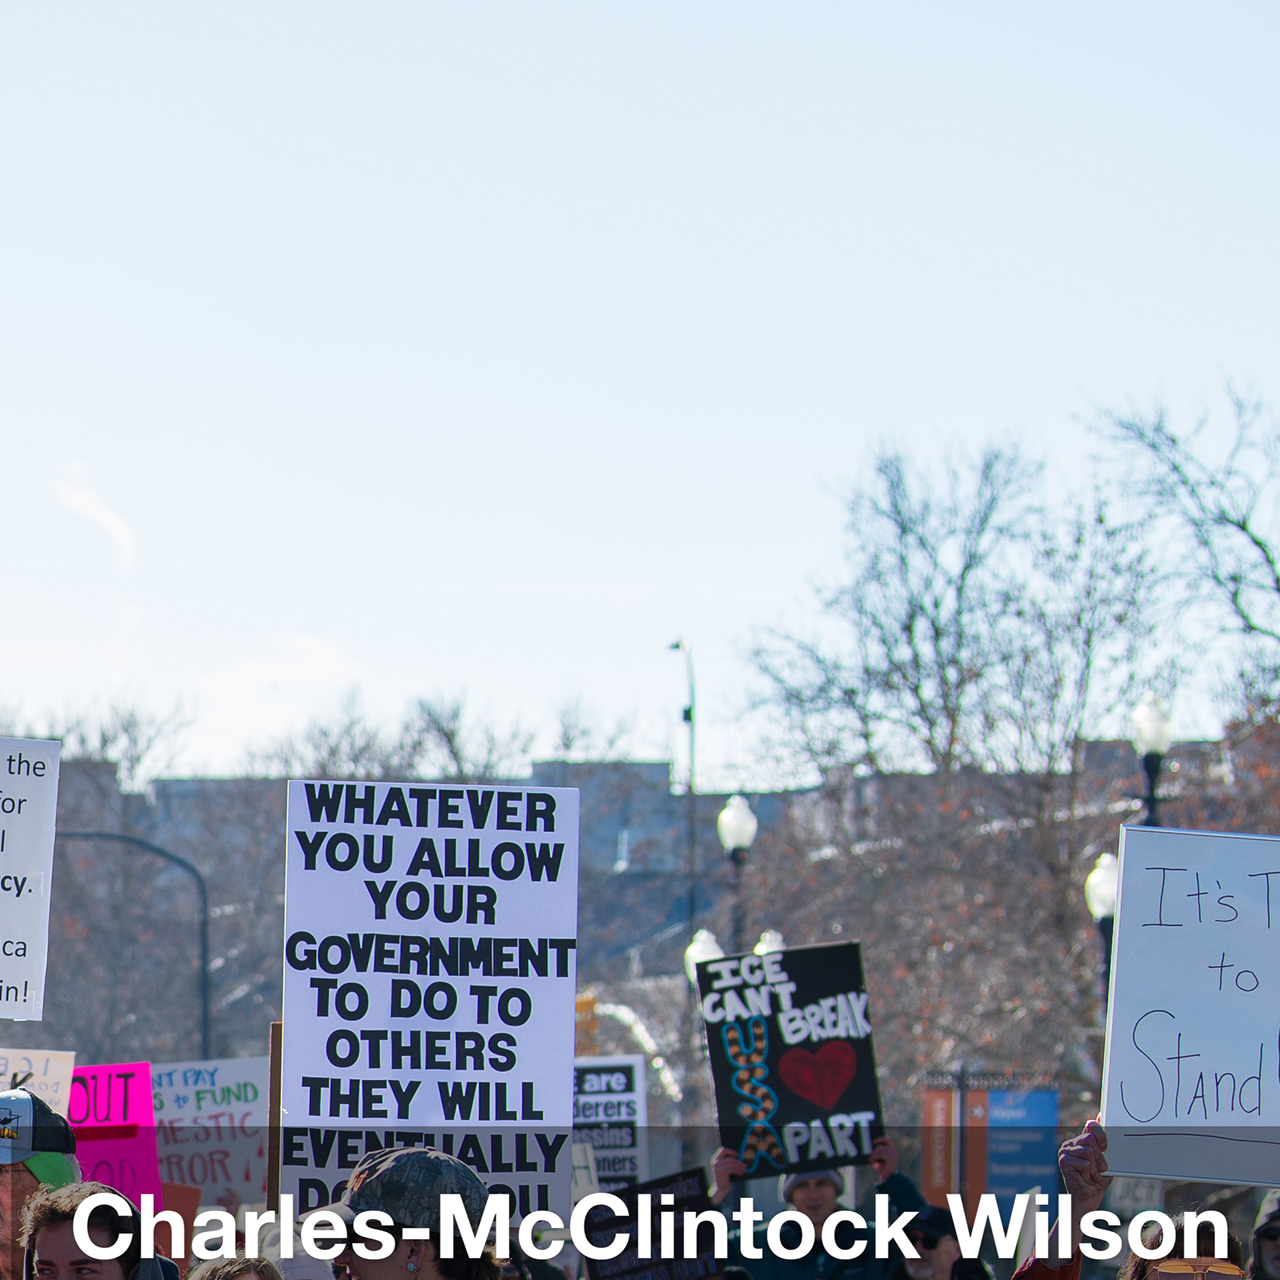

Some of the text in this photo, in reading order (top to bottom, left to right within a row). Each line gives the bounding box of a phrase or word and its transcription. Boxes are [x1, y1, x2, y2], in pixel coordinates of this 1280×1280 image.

[7, 752, 47, 777] the
[305, 783, 558, 833] WHATEVER
[295, 831, 566, 883] YOU ALLOW
[364, 881, 498, 925] YOUR
[1142, 867, 1238, 929] It's
[285, 931, 578, 978] GOVERNMENT
[706, 952, 790, 990] ICE
[1208, 952, 1260, 993] to
[309, 978, 533, 1027] TO DO TO
[702, 981, 797, 1023] CAN'T
[778, 992, 873, 1046] BREAK
[325, 1029, 518, 1073] OTHERS
[68, 1072, 136, 1124] OUT
[182, 1066, 220, 1087] PAY
[195, 1081, 259, 1112] FUND
[301, 1076, 546, 1122] THEY WILL
[584, 1071, 628, 1093] are
[721, 1015, 787, 1174] USA
[573, 1098, 638, 1119] derers
[783, 1111, 876, 1164] PART
